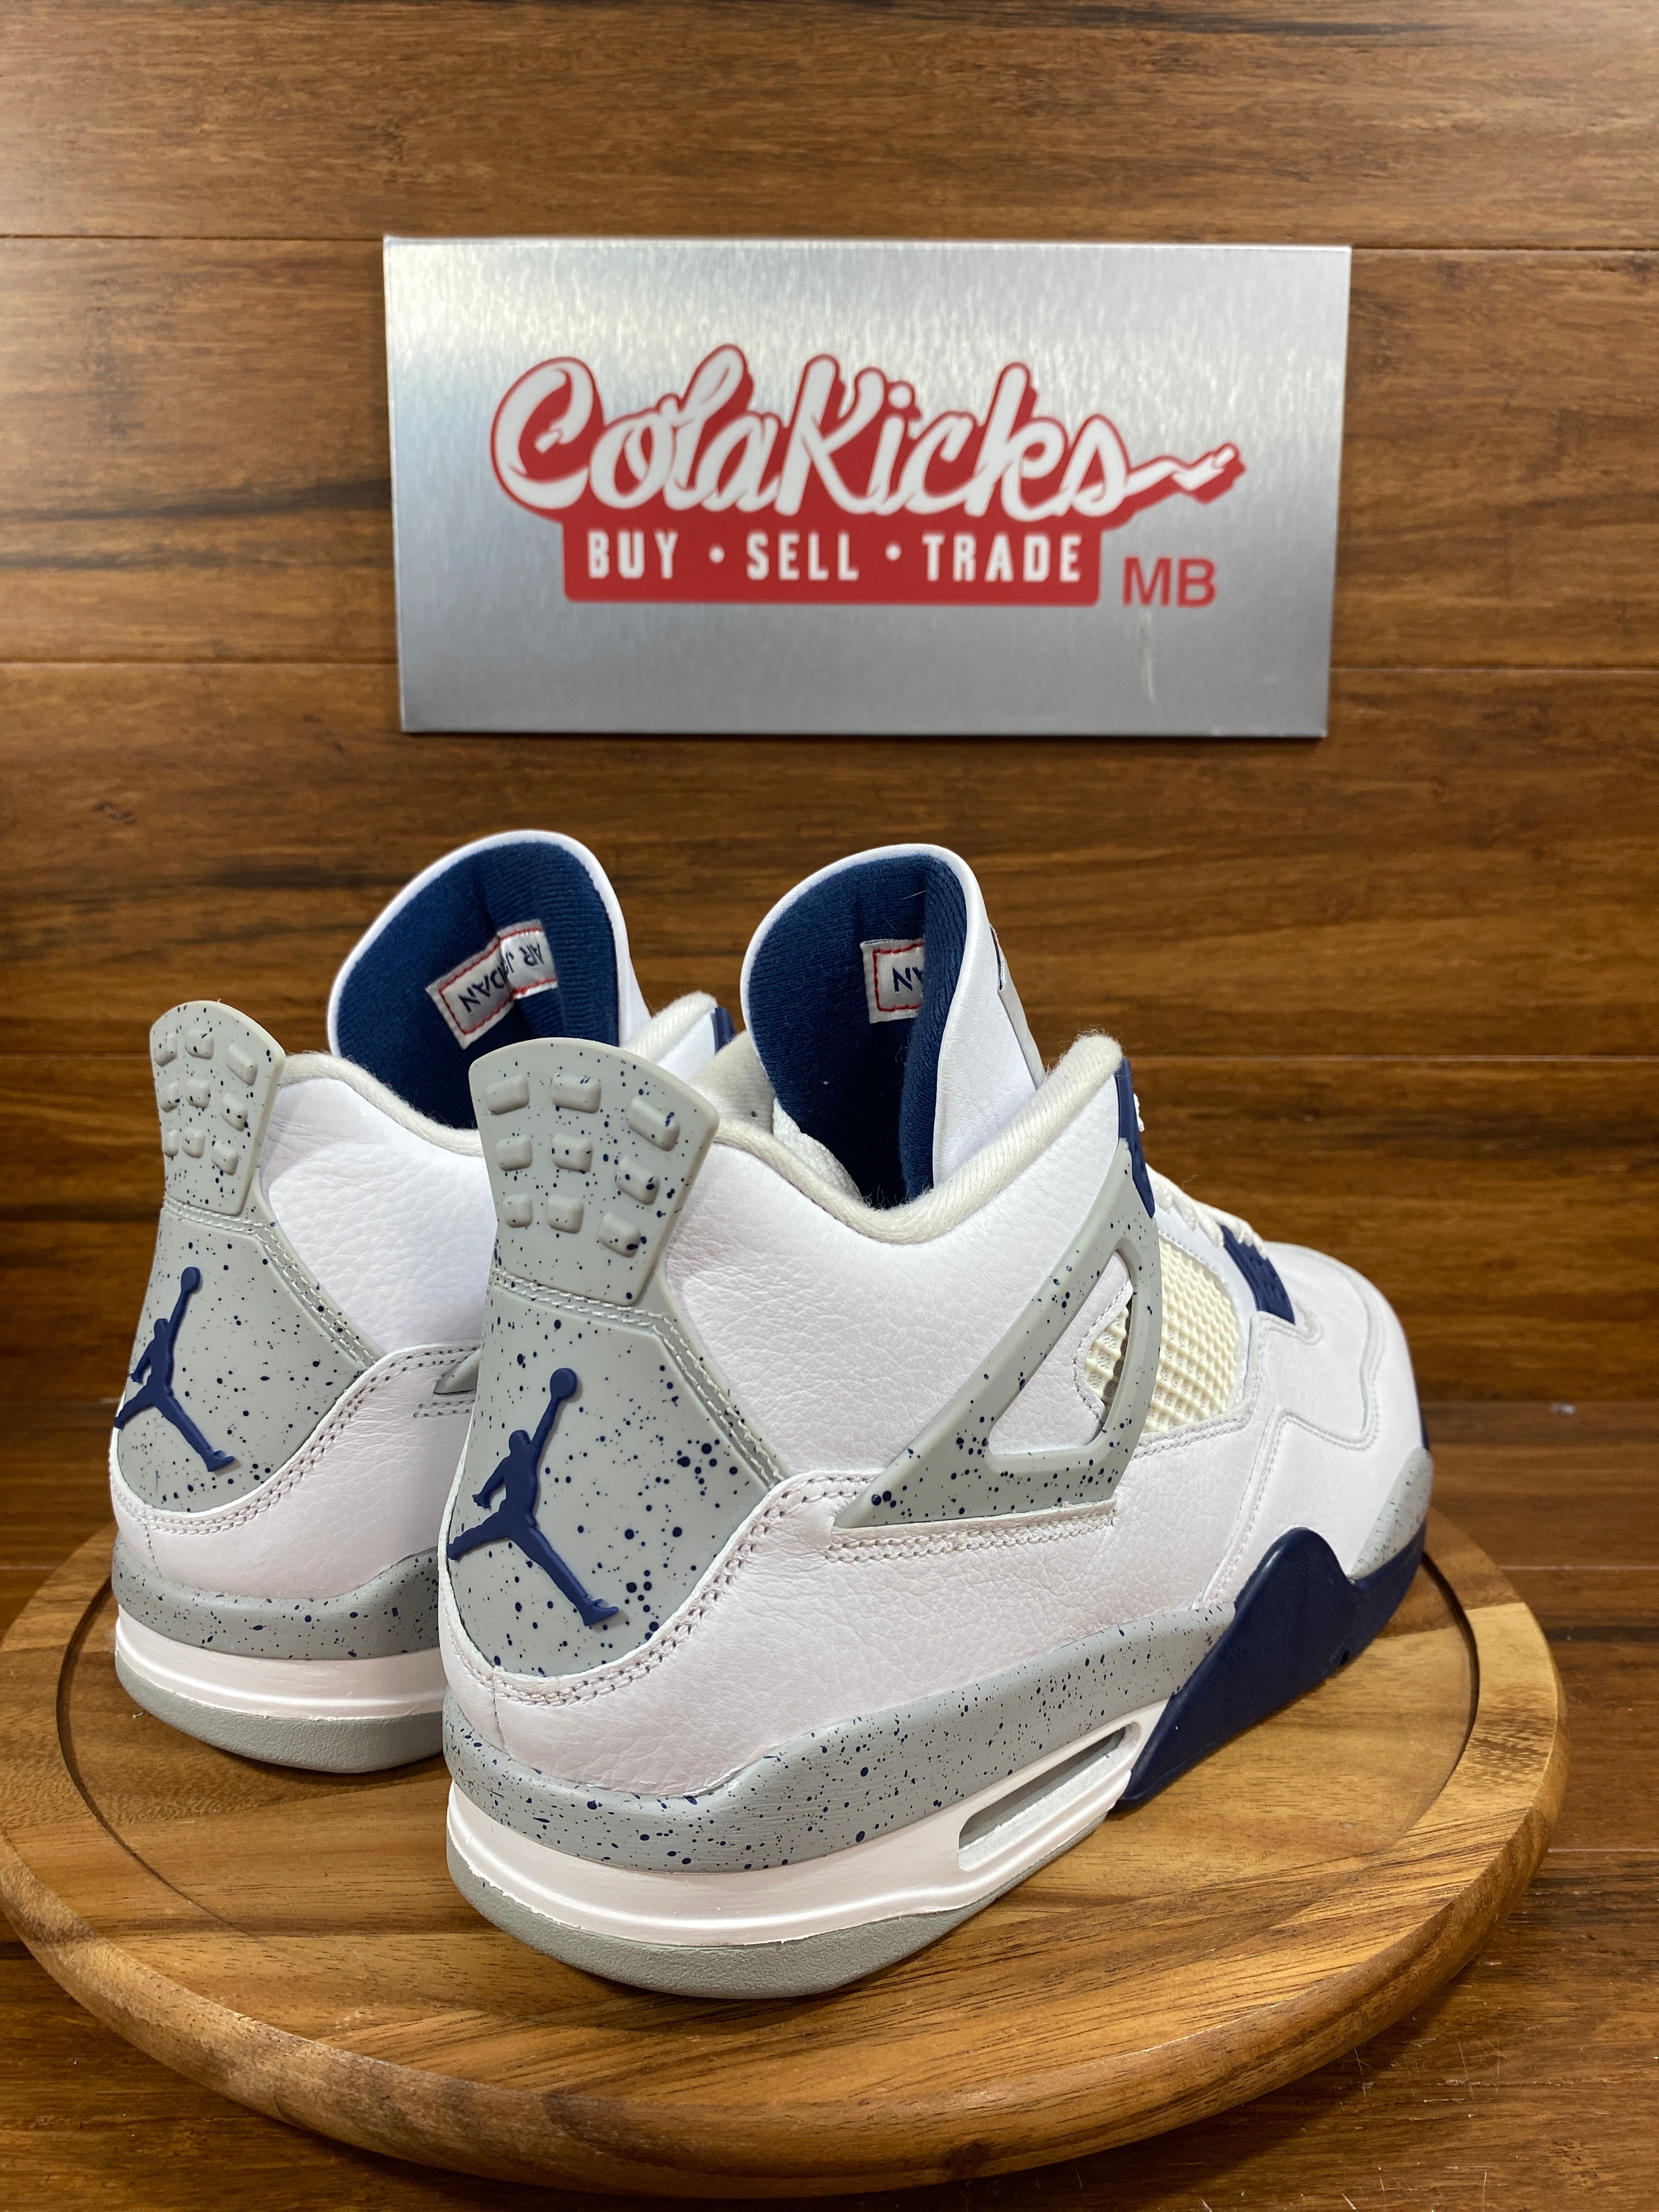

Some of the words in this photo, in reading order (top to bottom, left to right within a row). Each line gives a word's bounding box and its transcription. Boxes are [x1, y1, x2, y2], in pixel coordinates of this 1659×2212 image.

[588, 530, 678, 579] BUY
[747, 532, 859, 581] SELL
[922, 533, 1081, 583] TRADE
[1123, 556, 1216, 607] MB
[459, 951, 515, 1013] JDAN
